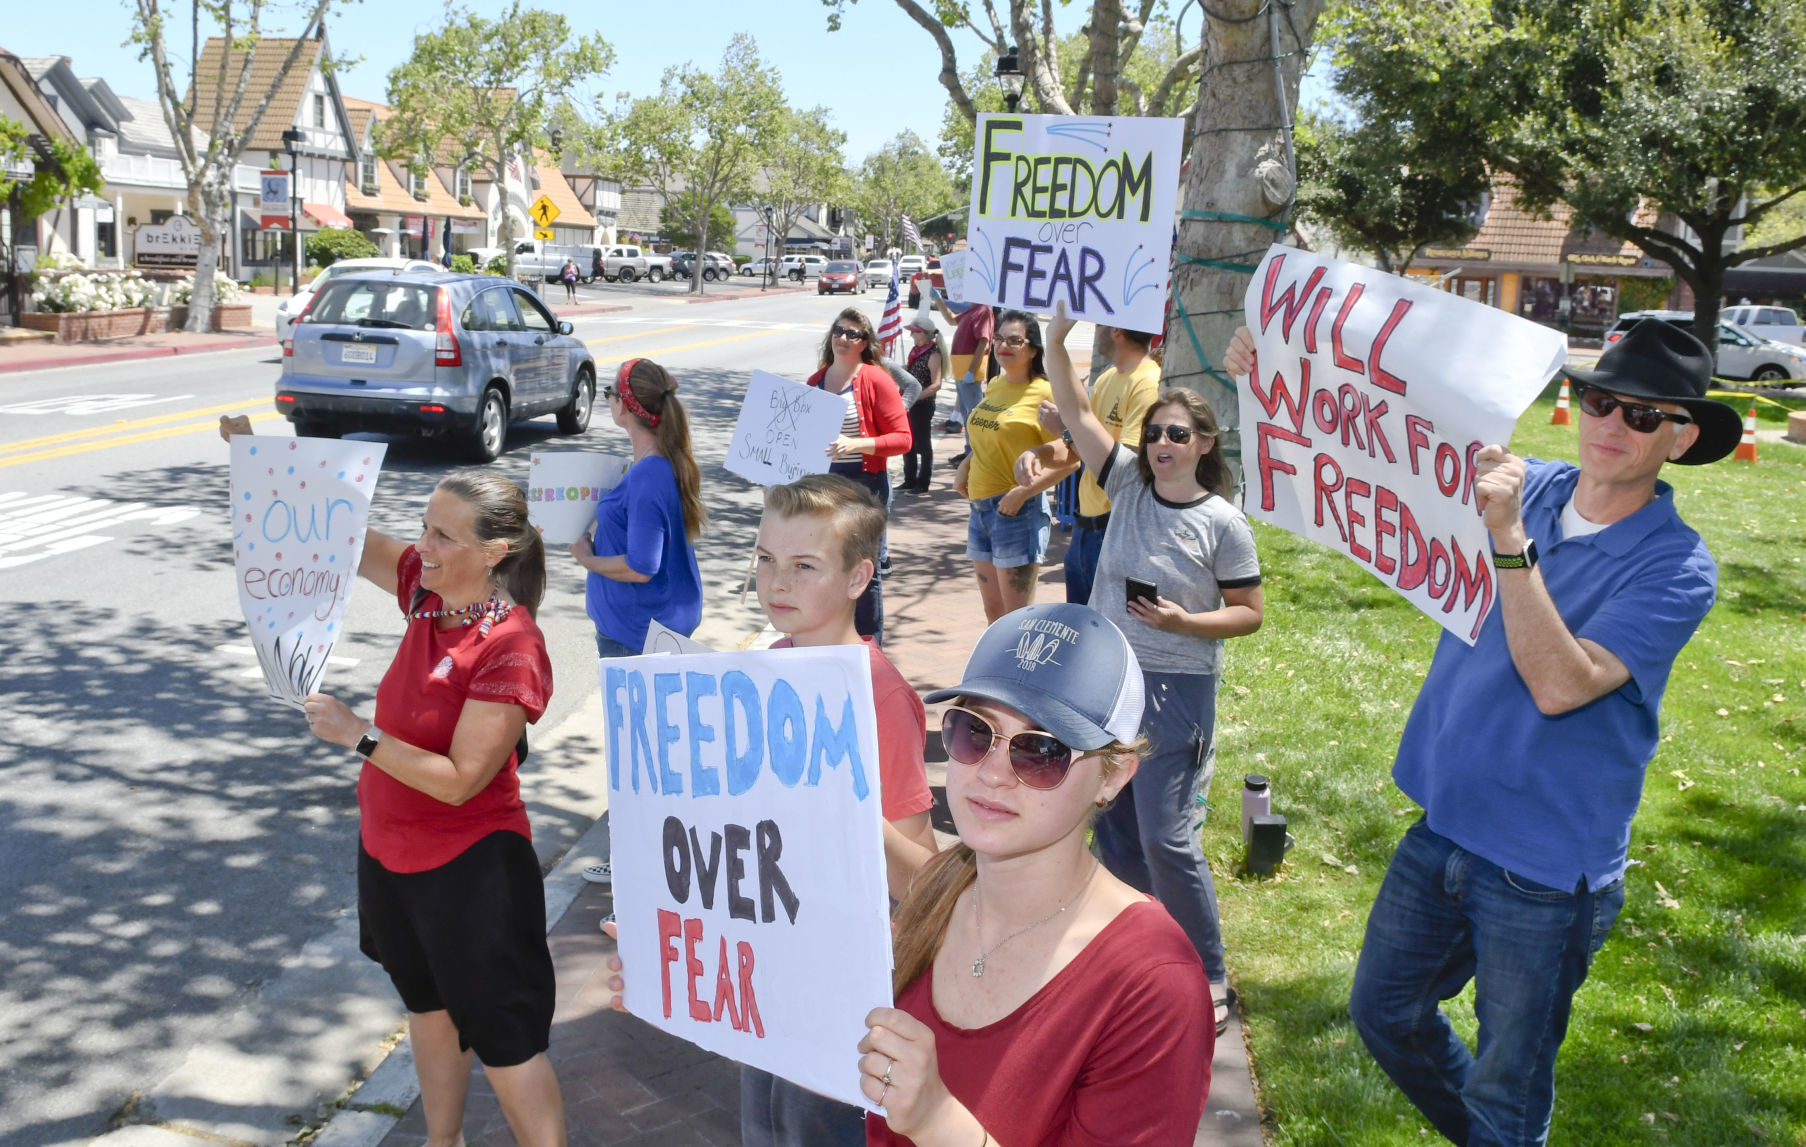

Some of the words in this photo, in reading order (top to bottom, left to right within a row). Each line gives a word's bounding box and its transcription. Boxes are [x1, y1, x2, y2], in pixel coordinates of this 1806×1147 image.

[979, 117, 1153, 225] FREEDOM
[998, 236, 1115, 314] FEAR
[1038, 221, 1094, 244] over
[1260, 253, 1414, 397] WILL
[1250, 352, 1397, 464] WORK
[262, 497, 353, 543] our
[1257, 421, 1493, 640] FREEDOM
[1017, 659, 1037, 672] 2018
[1035, 620, 1079, 645] CLEMENTE
[605, 666, 869, 802] FREEDOM
[662, 815, 800, 926] OVER
[657, 908, 765, 1039] FEAR
